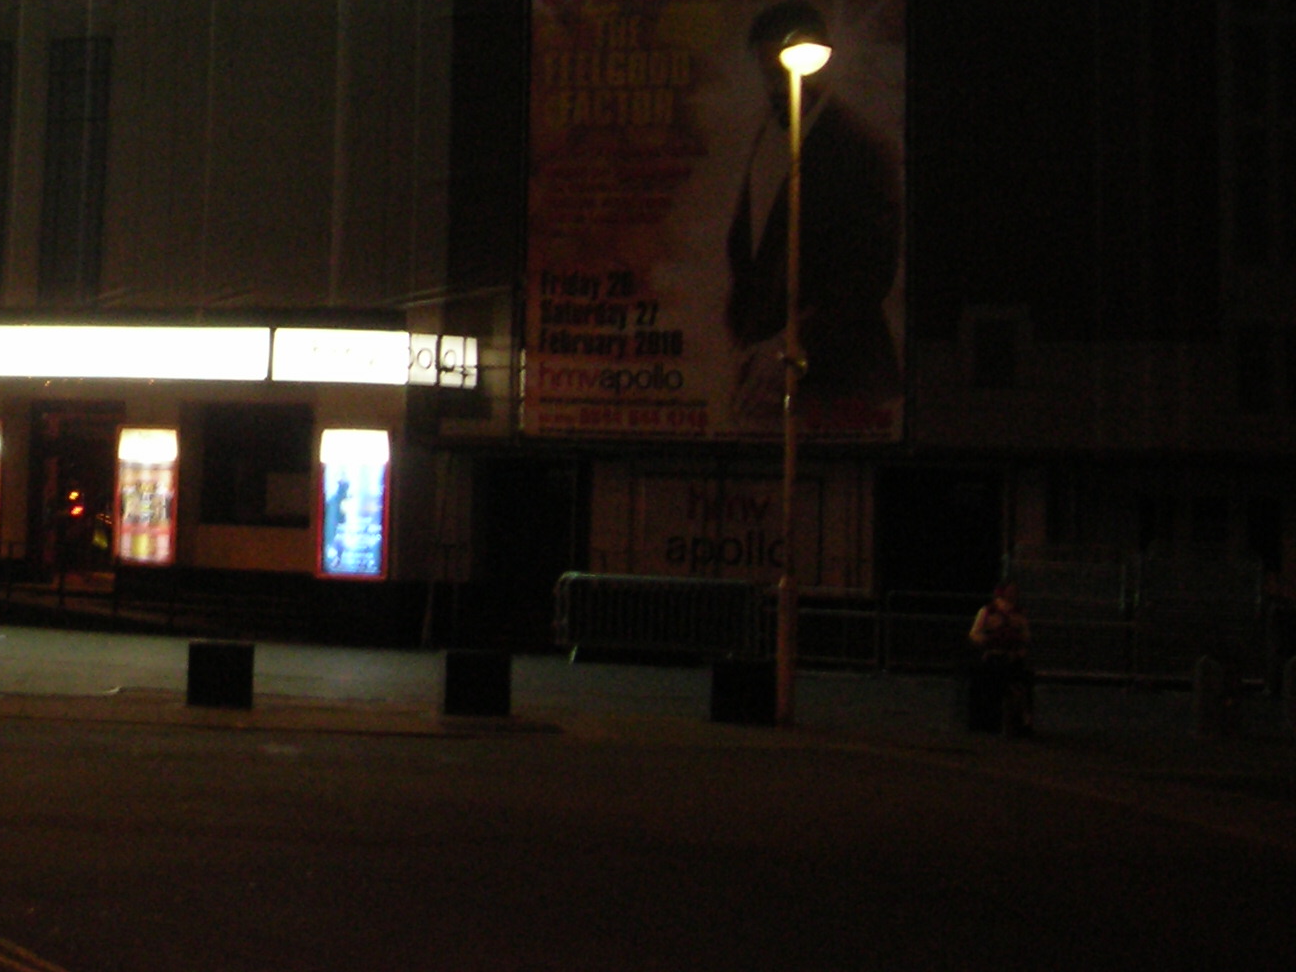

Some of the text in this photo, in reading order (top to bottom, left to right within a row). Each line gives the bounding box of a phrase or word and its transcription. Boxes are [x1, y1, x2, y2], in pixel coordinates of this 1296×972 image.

[540, 270, 600, 300] Friday
[540, 299, 659, 329] Saturday 27
[539, 328, 628, 359] February
[539, 361, 685, 394] hmvapollo
[687, 481, 772, 522] hmv
